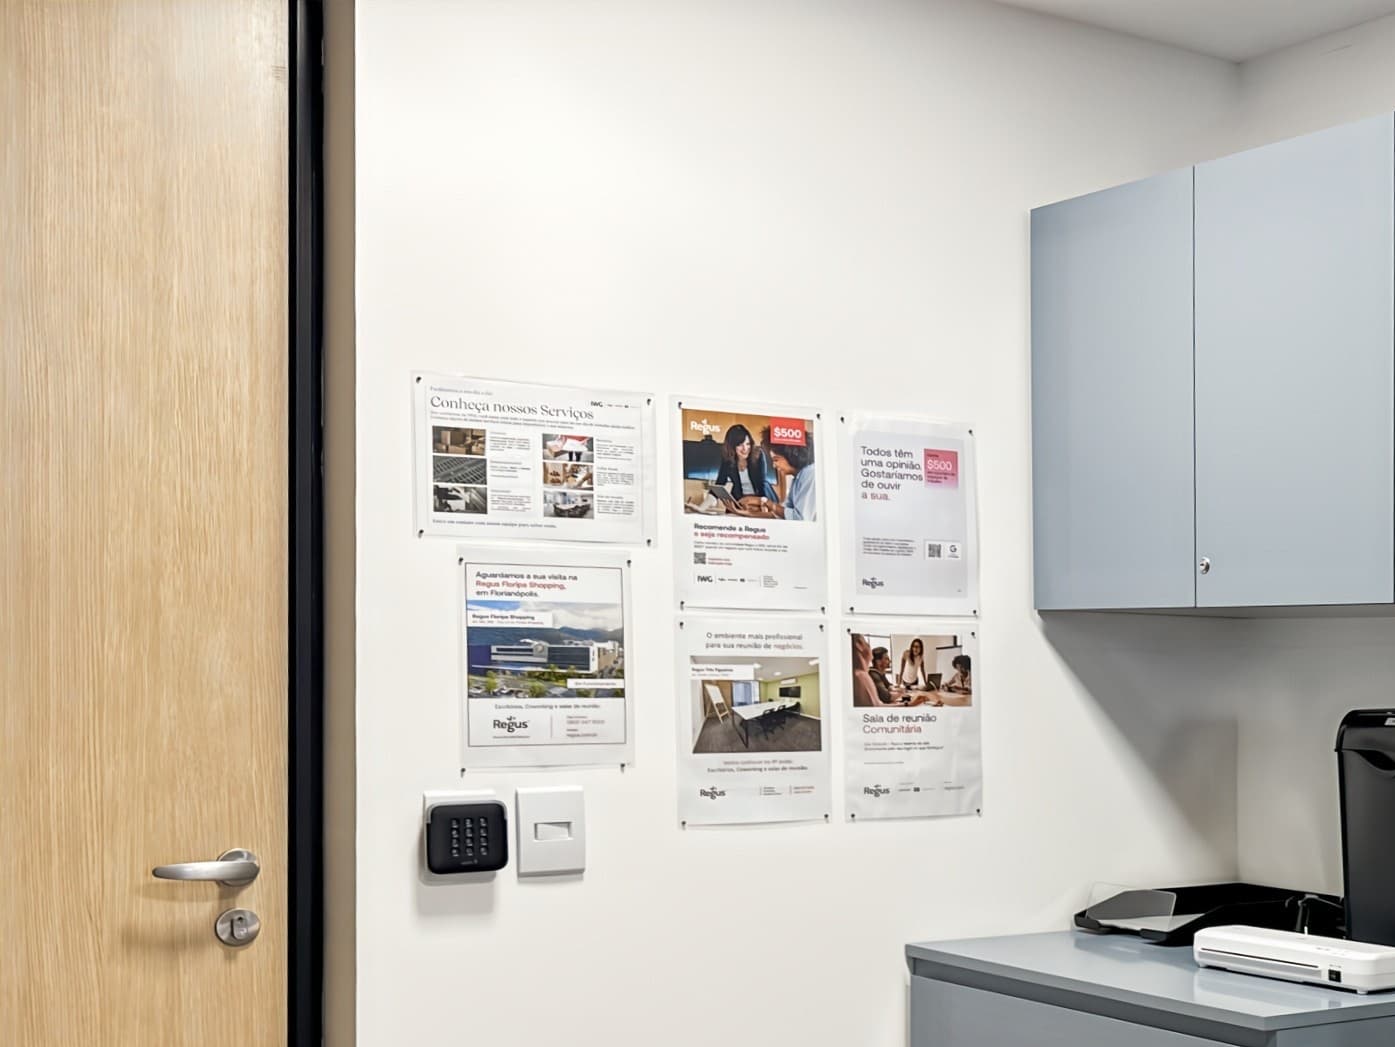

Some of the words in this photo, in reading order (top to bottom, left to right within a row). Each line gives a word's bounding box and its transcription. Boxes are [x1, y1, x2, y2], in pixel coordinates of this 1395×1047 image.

[430, 395, 490, 413] Conheça
[493, 402, 538, 416] nossos
[540, 404, 594, 421] Serviços
[690, 418, 721, 435] Regus
[774, 426, 802, 439] $500
[860, 446, 892, 459] Todos
[894, 447, 914, 459] têm
[860, 460, 884, 469] uma
[927, 459, 953, 471] $500
[861, 479, 875, 489] de
[877, 480, 902, 490] ouvir
[861, 492, 868, 500] a
[694, 523, 737, 532] Recomende
[745, 525, 767, 534] Regus
[475, 571, 525, 580] Aguardamos
[548, 573, 567, 581] visita
[475, 580, 500, 588] Regus
[862, 577, 885, 589] Regus
[863, 713, 884, 723] Sala
[886, 713, 899, 723] de
[902, 712, 937, 723] reunião
[492, 716, 529, 733] Regus
[863, 724, 922, 734] Comunitária
[700, 786, 726, 800] Regus
[863, 784, 890, 797] Regus
